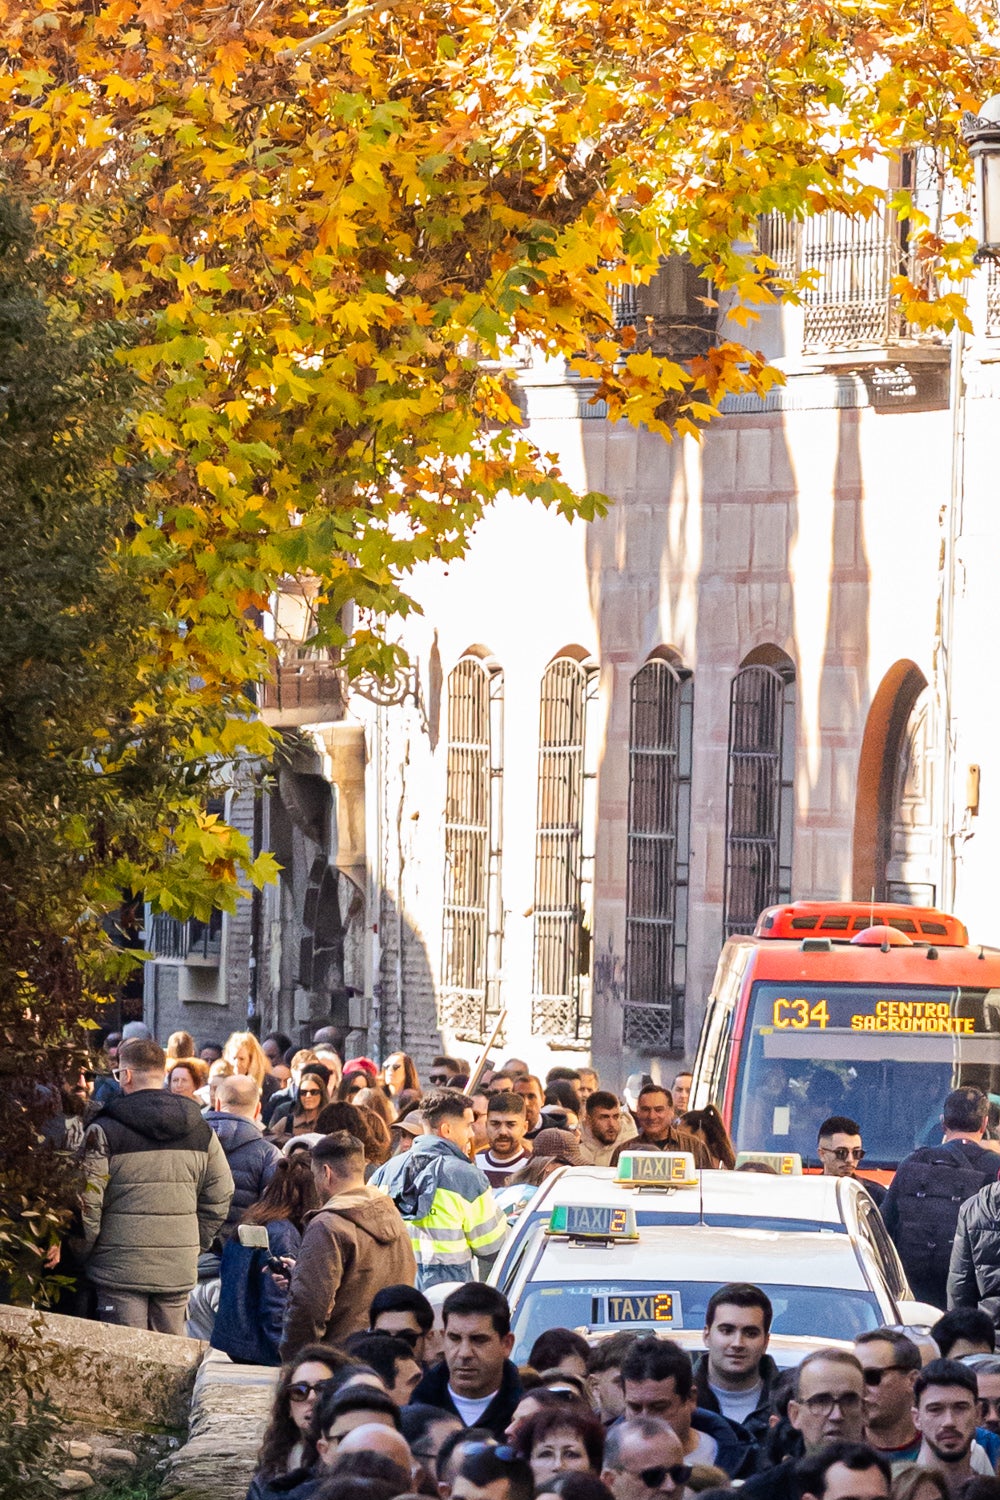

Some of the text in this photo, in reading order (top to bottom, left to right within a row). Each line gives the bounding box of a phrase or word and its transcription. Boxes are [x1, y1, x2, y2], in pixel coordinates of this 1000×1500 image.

[772, 998, 830, 1030] C34
[875, 1000, 950, 1017] CENTRO
[850, 1014, 975, 1034] SACROMONTE
[636, 1156, 686, 1179] TAXI 2
[572, 1207, 627, 1232] TAXI 2
[609, 1293, 673, 1321] TAXI 2
